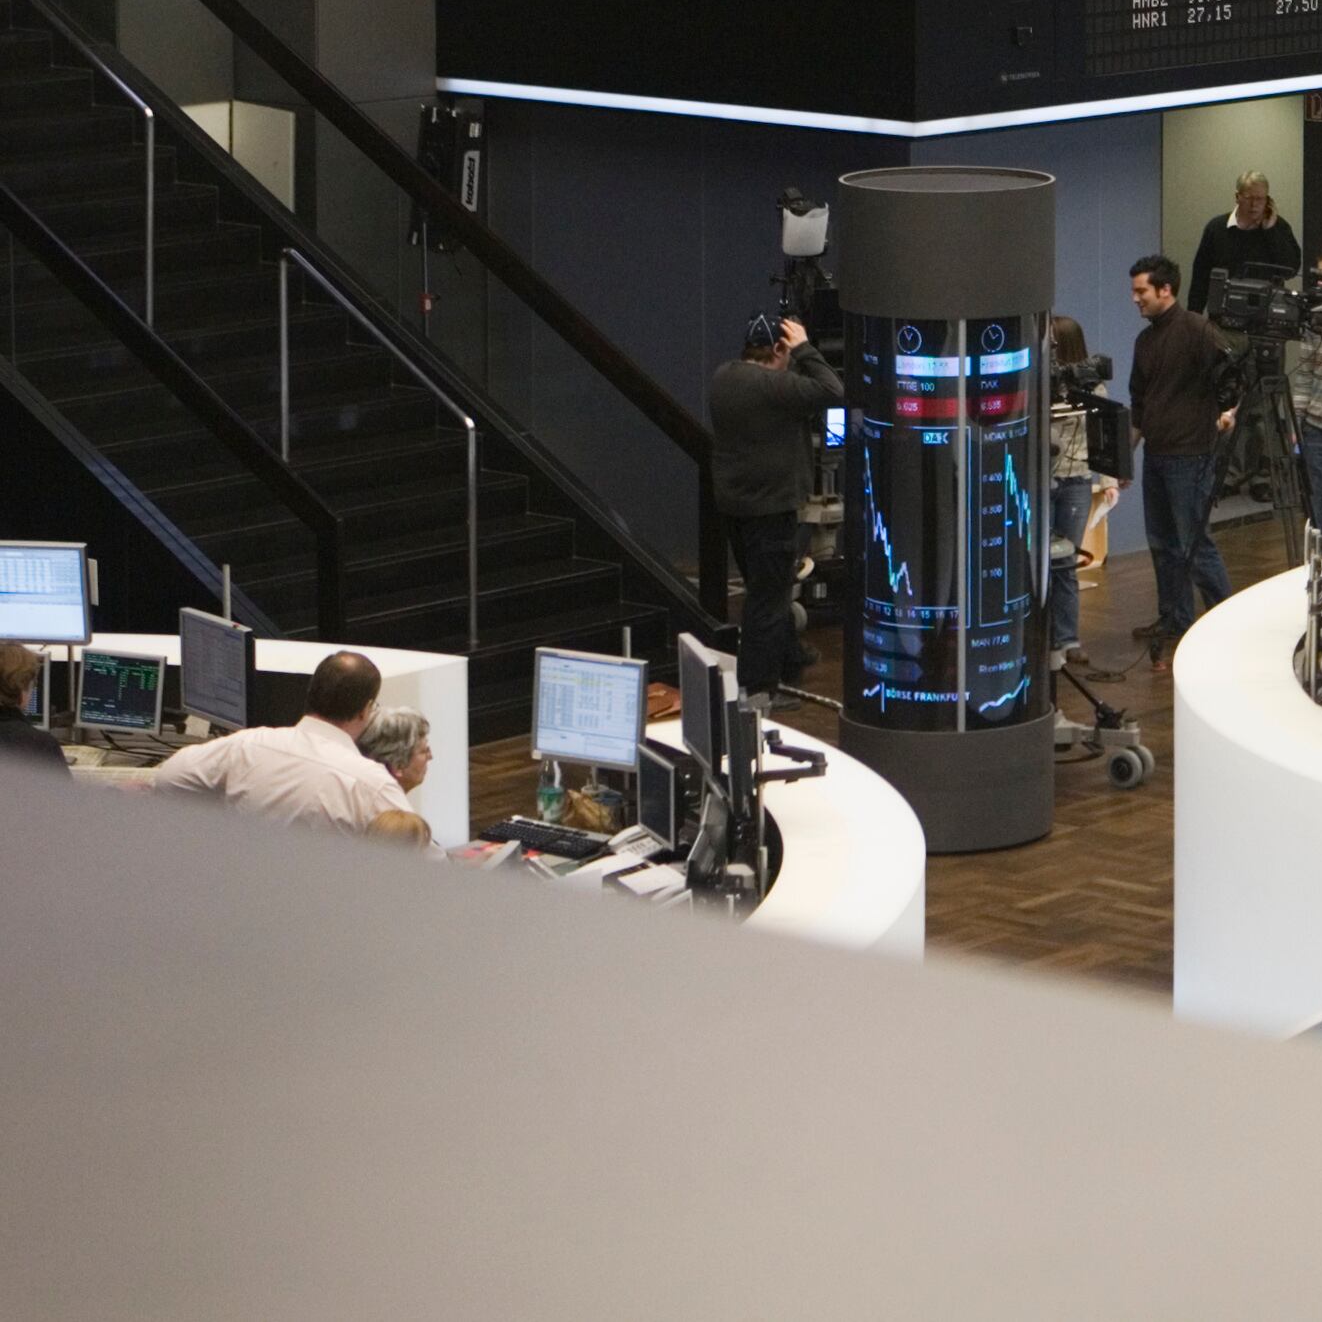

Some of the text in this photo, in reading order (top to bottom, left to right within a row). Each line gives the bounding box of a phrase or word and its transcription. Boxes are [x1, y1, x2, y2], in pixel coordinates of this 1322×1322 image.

[1133, 12, 1166, 27] HNR1
[921, 383, 935, 391] 100
[914, 691, 970, 702] FRANKFUT
